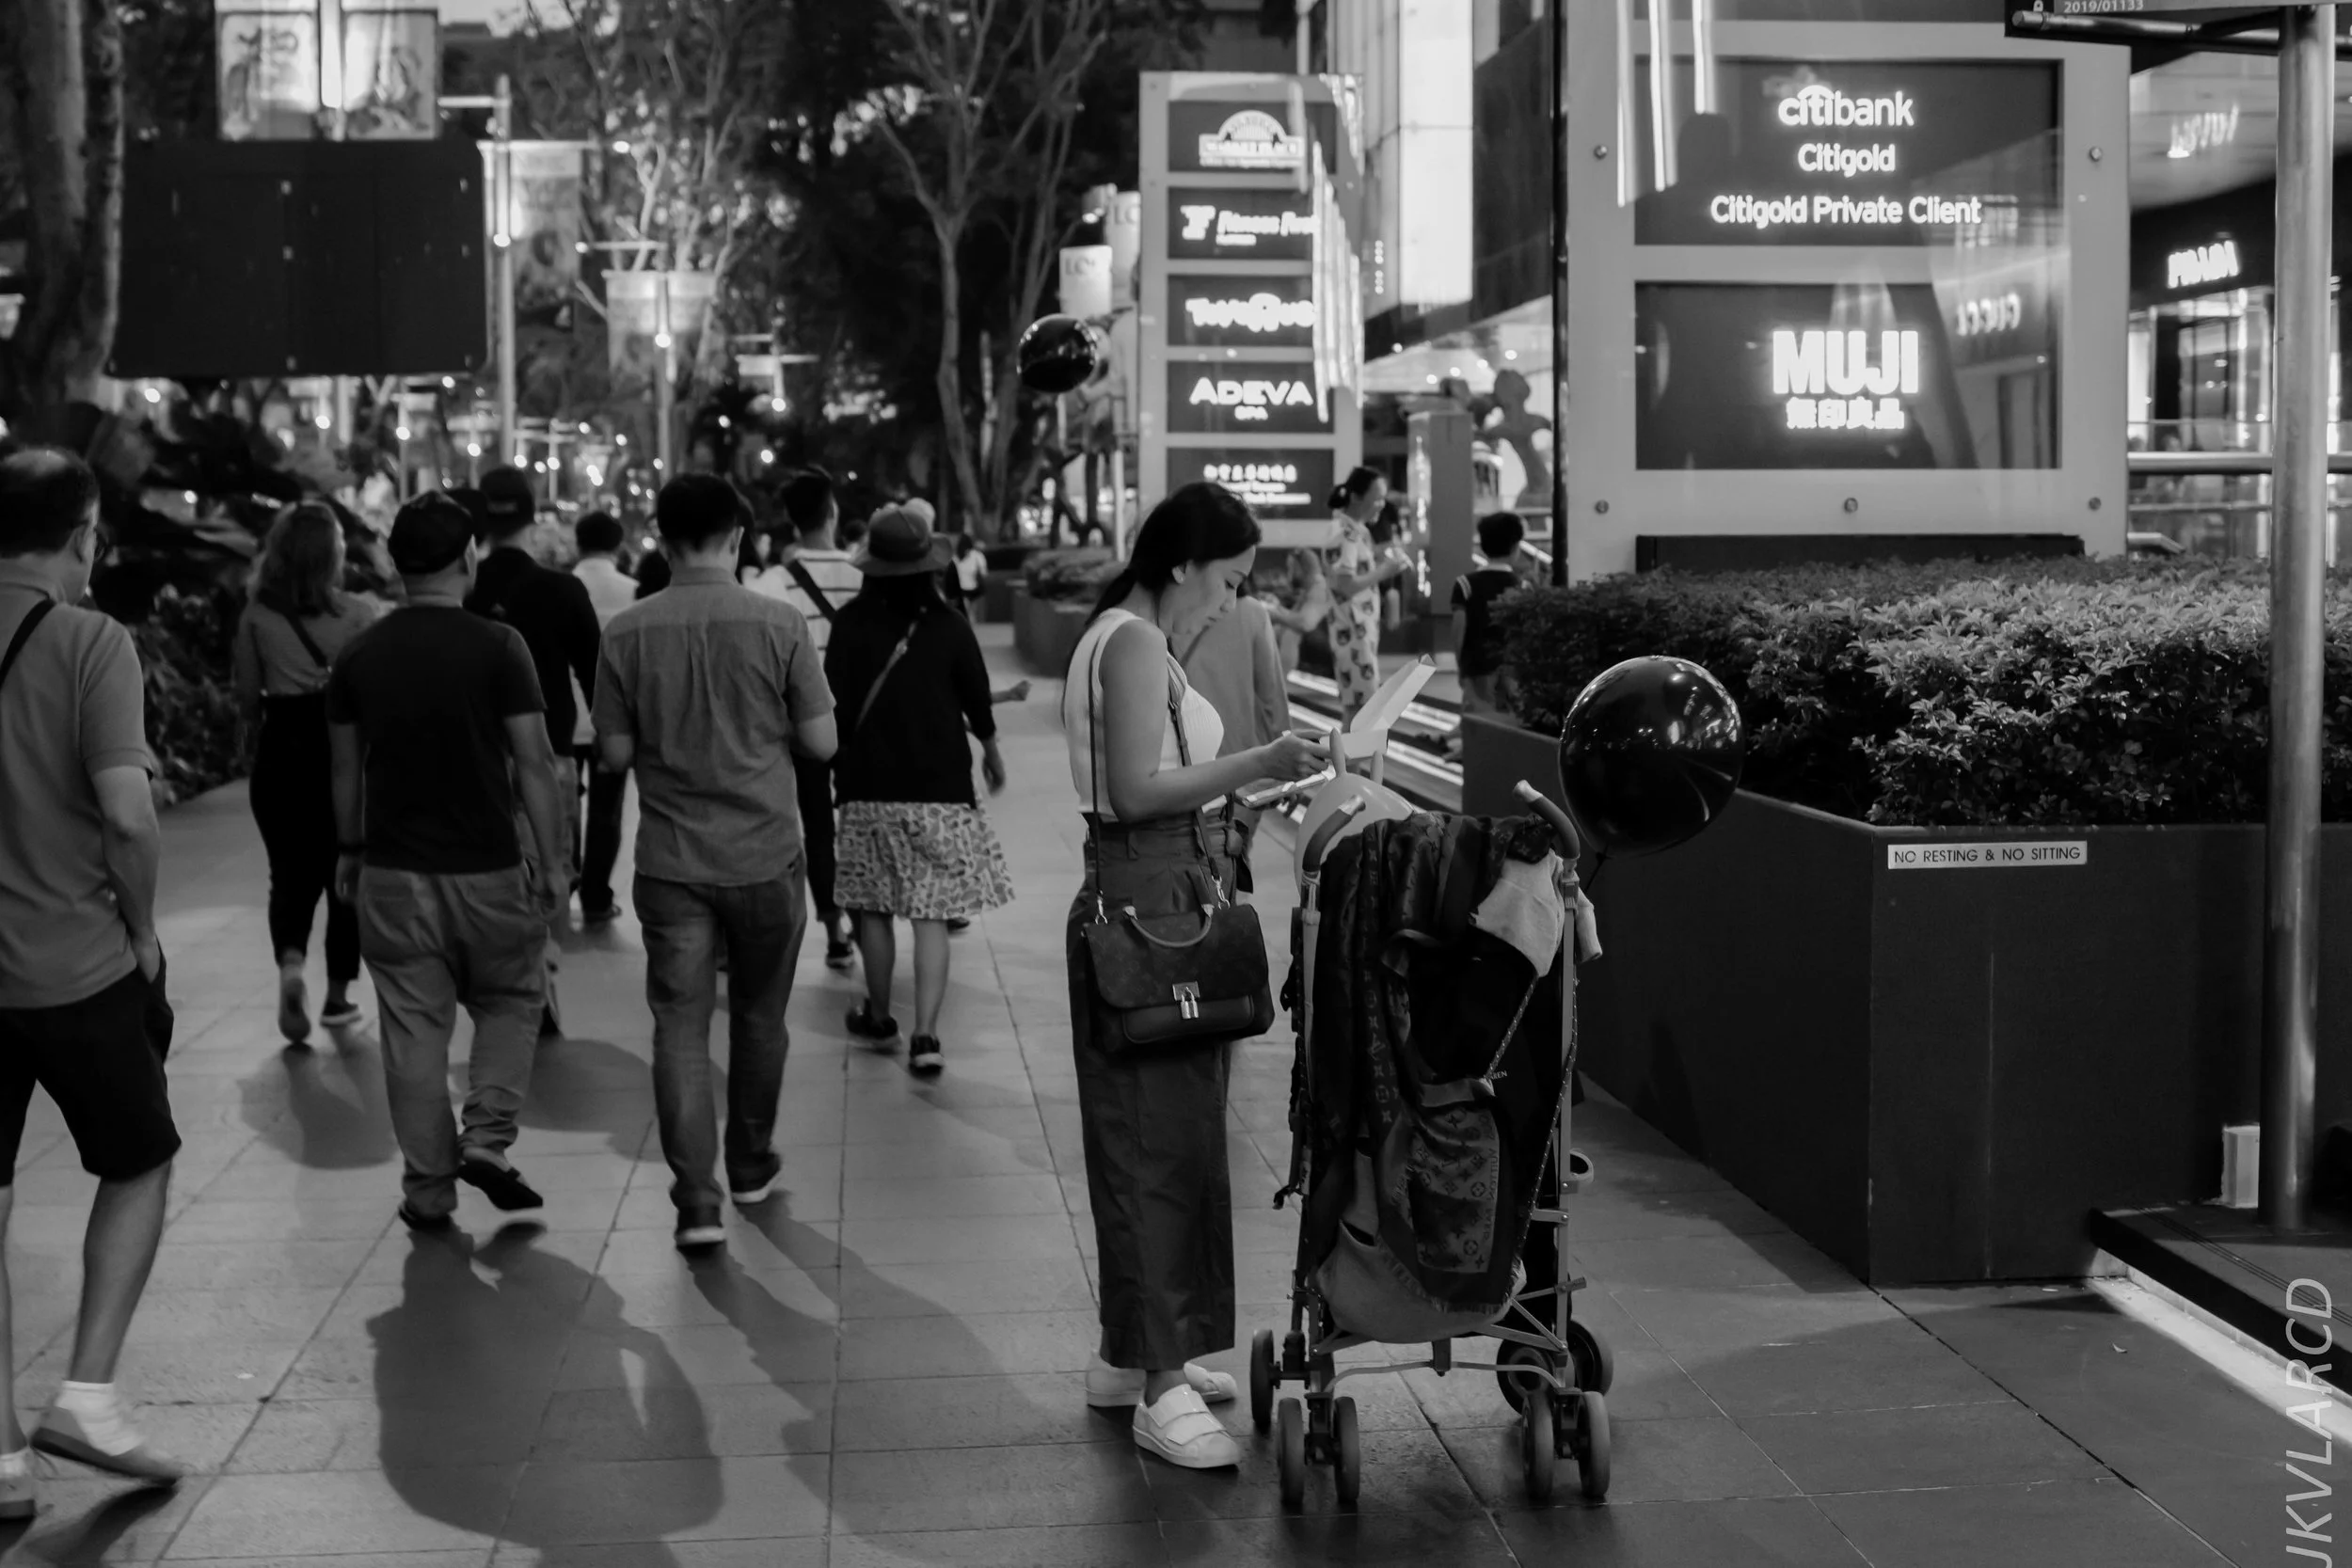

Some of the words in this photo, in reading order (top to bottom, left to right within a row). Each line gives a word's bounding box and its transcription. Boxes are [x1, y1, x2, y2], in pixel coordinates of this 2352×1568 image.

[1778, 85, 1914, 126] citibank
[1798, 143, 1896, 177] Citigold
[1710, 195, 1807, 229] Citigold
[1814, 195, 1903, 224] Private
[1909, 195, 1981, 224] Client
[1772, 330, 1919, 395] MUJI
[1189, 377, 1313, 405] ADEVA
[1894, 850, 1916, 863] NO
[1923, 848, 1979, 863] RESTING
[1985, 848, 1995, 862] &
[2002, 847, 2025, 862] NO
[2030, 847, 2081, 860] SITTING
